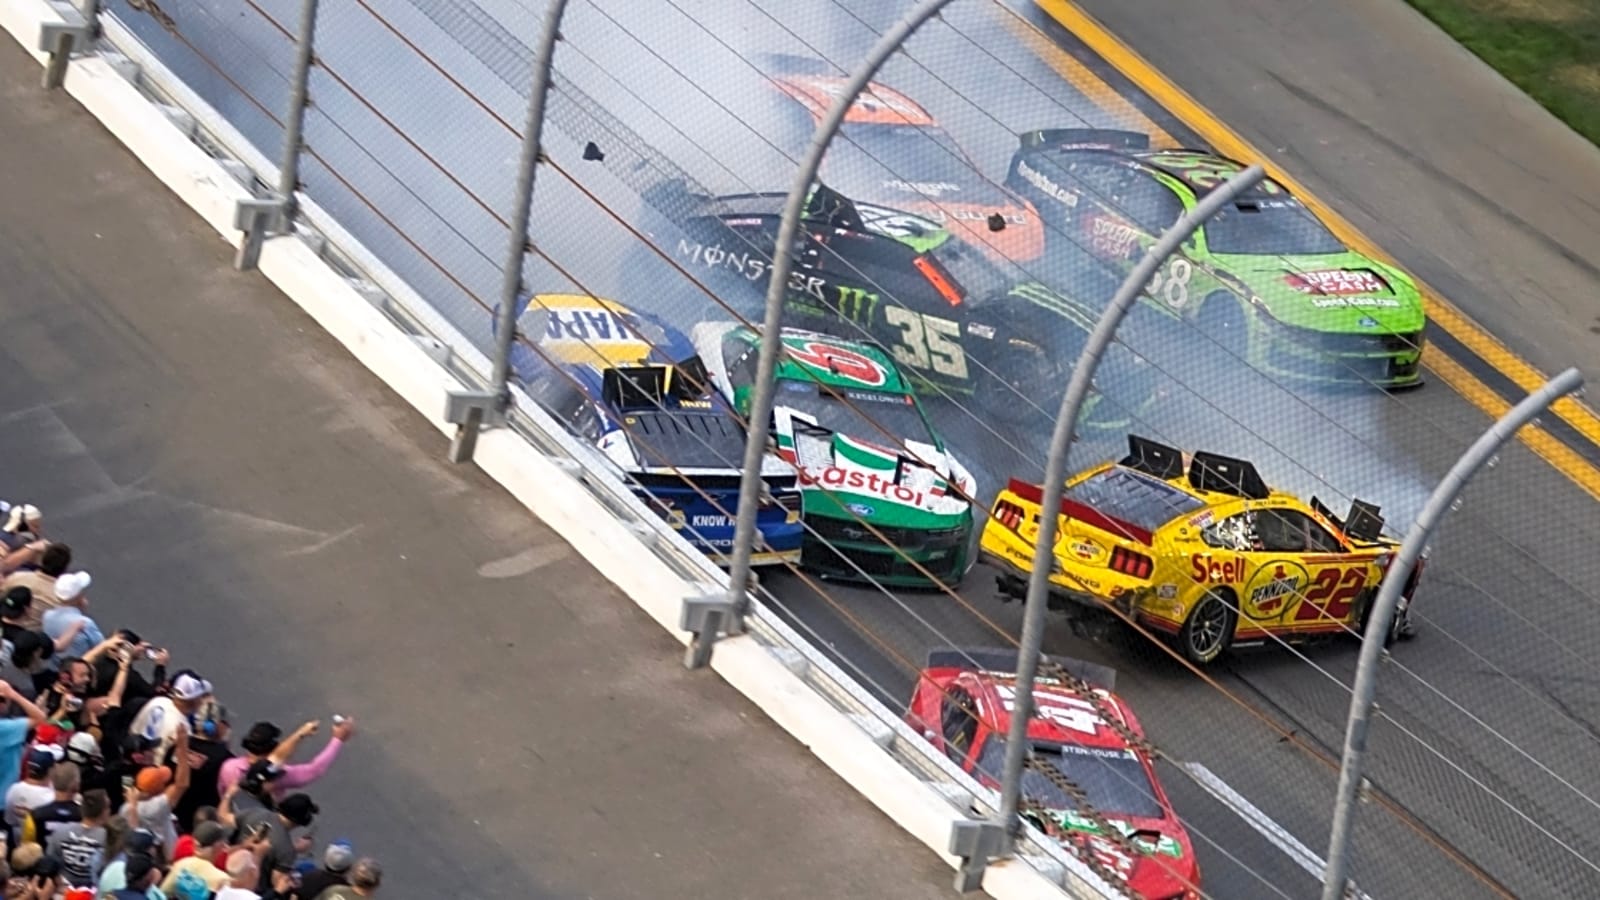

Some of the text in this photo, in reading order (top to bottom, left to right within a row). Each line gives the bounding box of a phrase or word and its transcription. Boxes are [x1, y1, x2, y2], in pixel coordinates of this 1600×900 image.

[884, 304, 969, 379] 35
[692, 514, 726, 527] KNOW
[1191, 553, 1246, 585] Shell
[1294, 567, 1369, 621] 22
